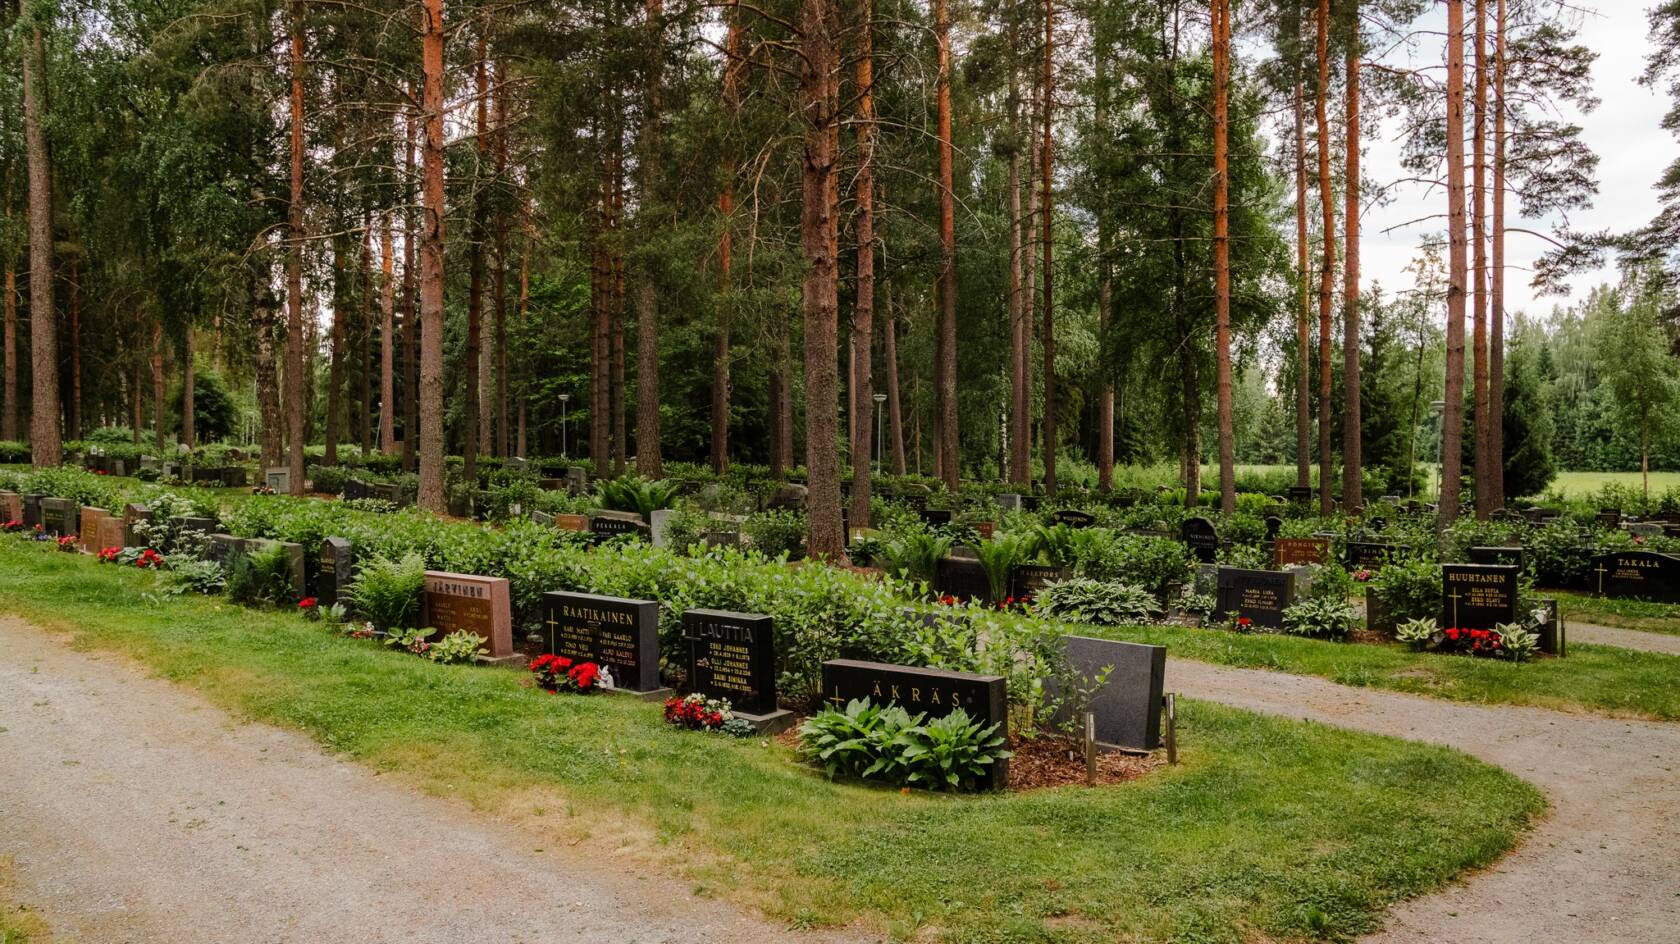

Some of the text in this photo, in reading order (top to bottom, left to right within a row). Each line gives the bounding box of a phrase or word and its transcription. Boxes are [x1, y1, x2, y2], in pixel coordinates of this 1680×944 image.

[1618, 558, 1660, 568] TAKALA
[1449, 573, 1505, 583] HUUHTANEN
[432, 581, 483, 597] JÄRVINEN
[563, 605, 634, 625] RAATIKAINEN
[700, 622, 753, 643] LAUTTIA
[873, 680, 961, 707] ÄKRÄS
